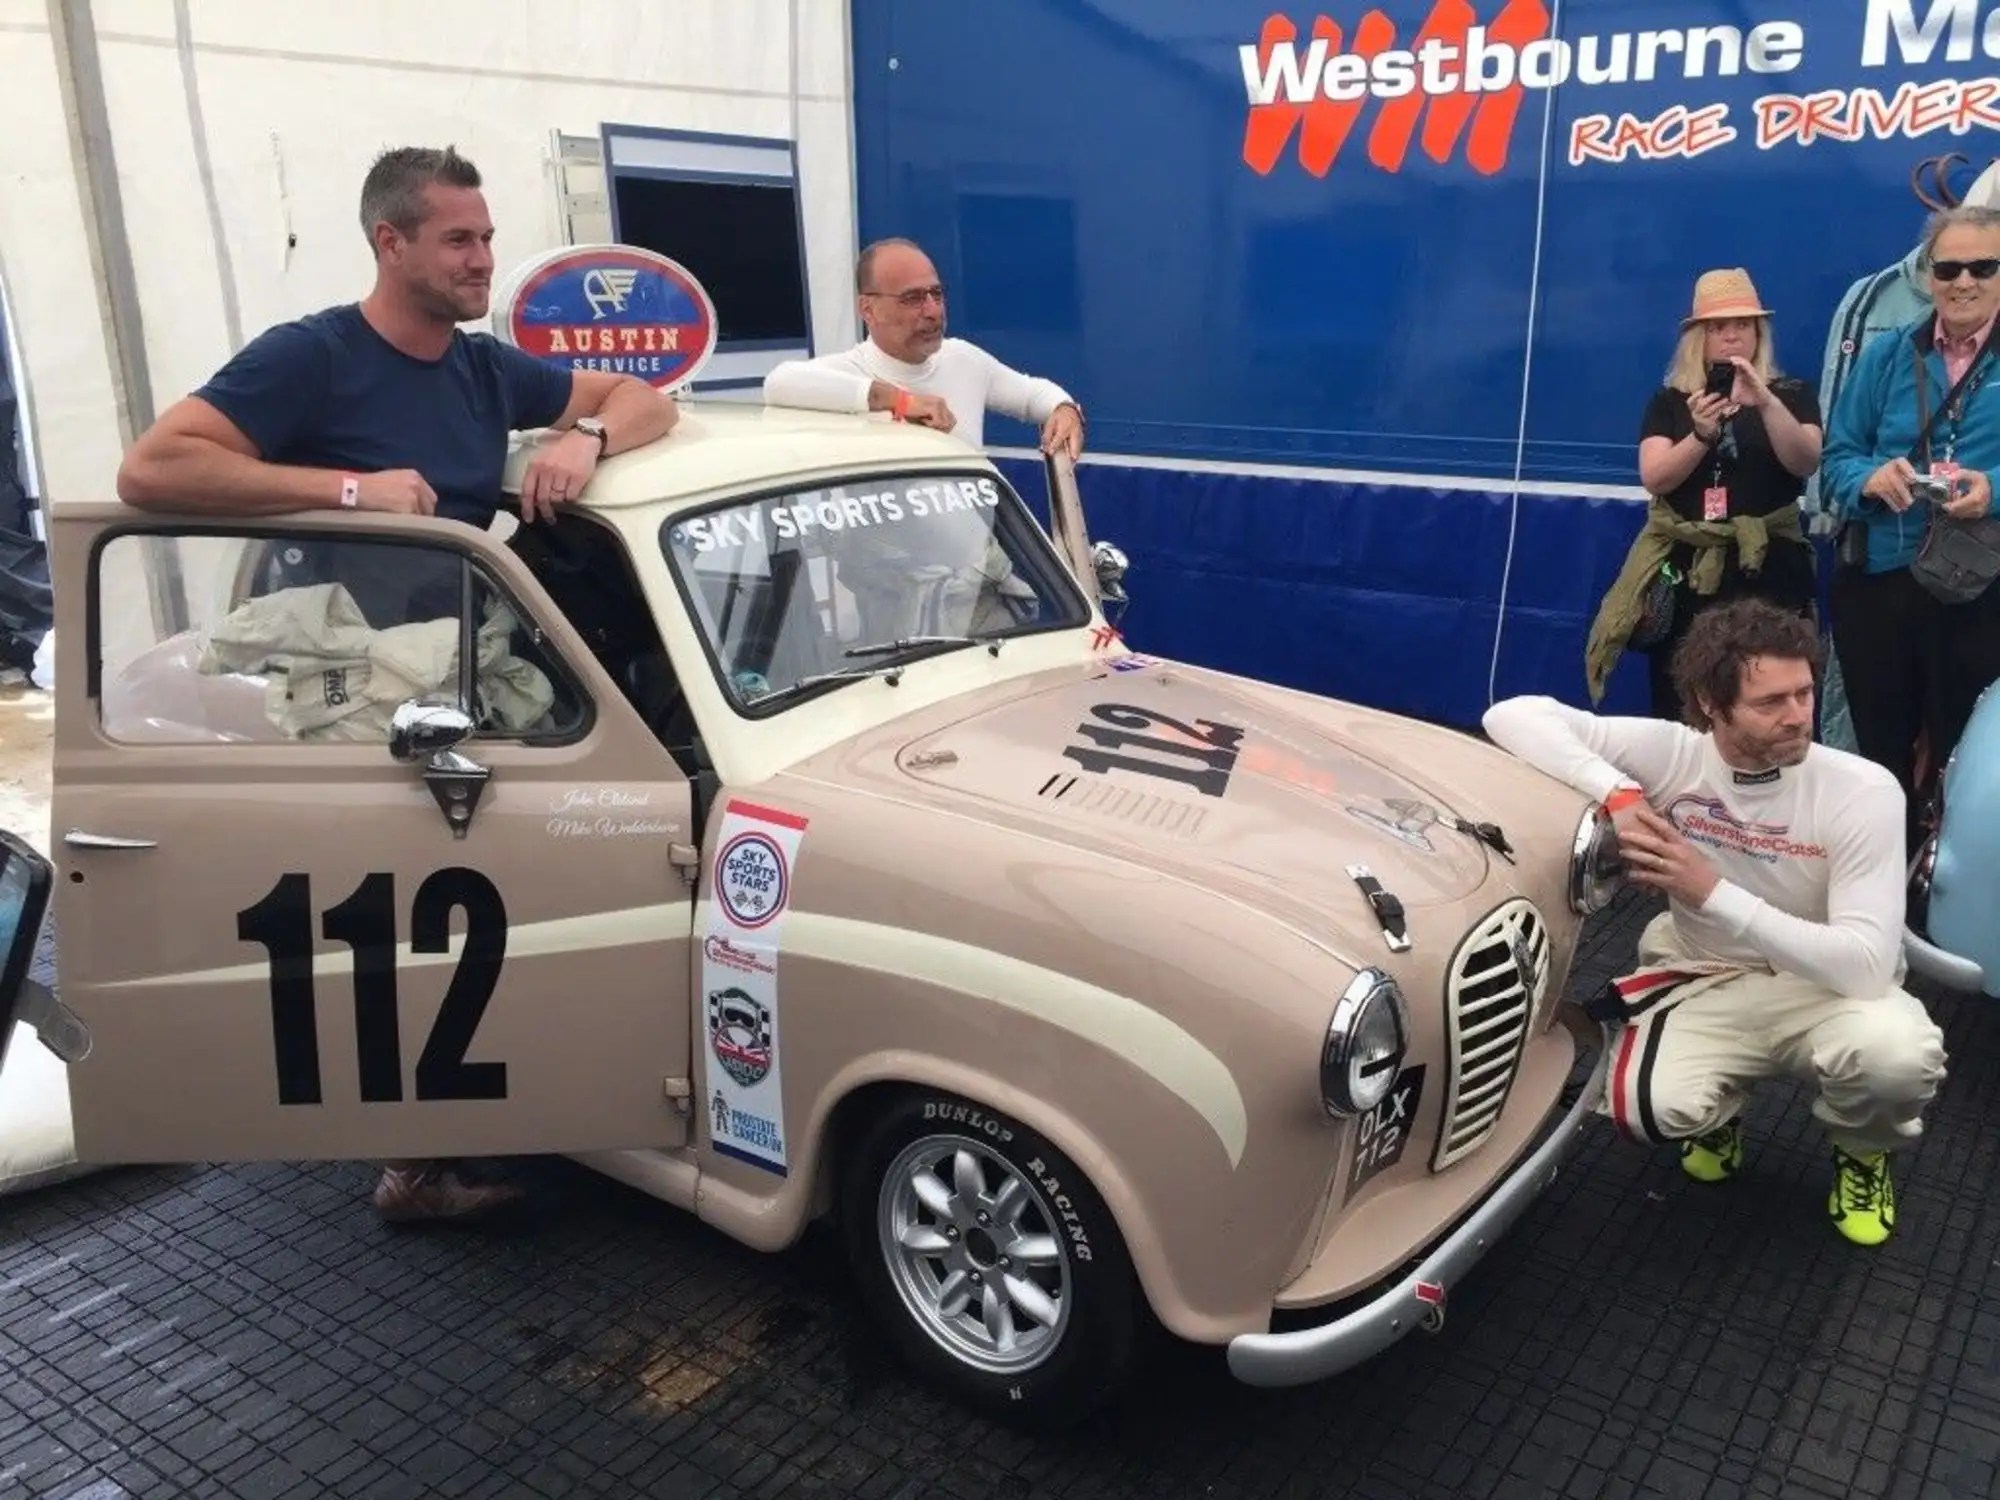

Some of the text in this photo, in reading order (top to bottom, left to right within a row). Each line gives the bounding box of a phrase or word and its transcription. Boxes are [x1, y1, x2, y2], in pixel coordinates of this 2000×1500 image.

[1238, 19, 1804, 105] Westbourne
[1570, 104, 1736, 165] RACE
[549, 327, 679, 353] AUSTIN
[573, 356, 661, 373] SERVICE
[687, 478, 1000, 552] SKY SPORTS STARS
[1062, 702, 1245, 798] 112
[727, 858, 777, 883] SPORTS
[730, 872, 770, 892] STARS
[741, 848, 767, 865] SKY
[236, 866, 508, 1105] 112
[923, 1102, 1015, 1143] DUNLOP
[1360, 1086, 1412, 1146] OLX
[1026, 1156, 1093, 1262] RACING
